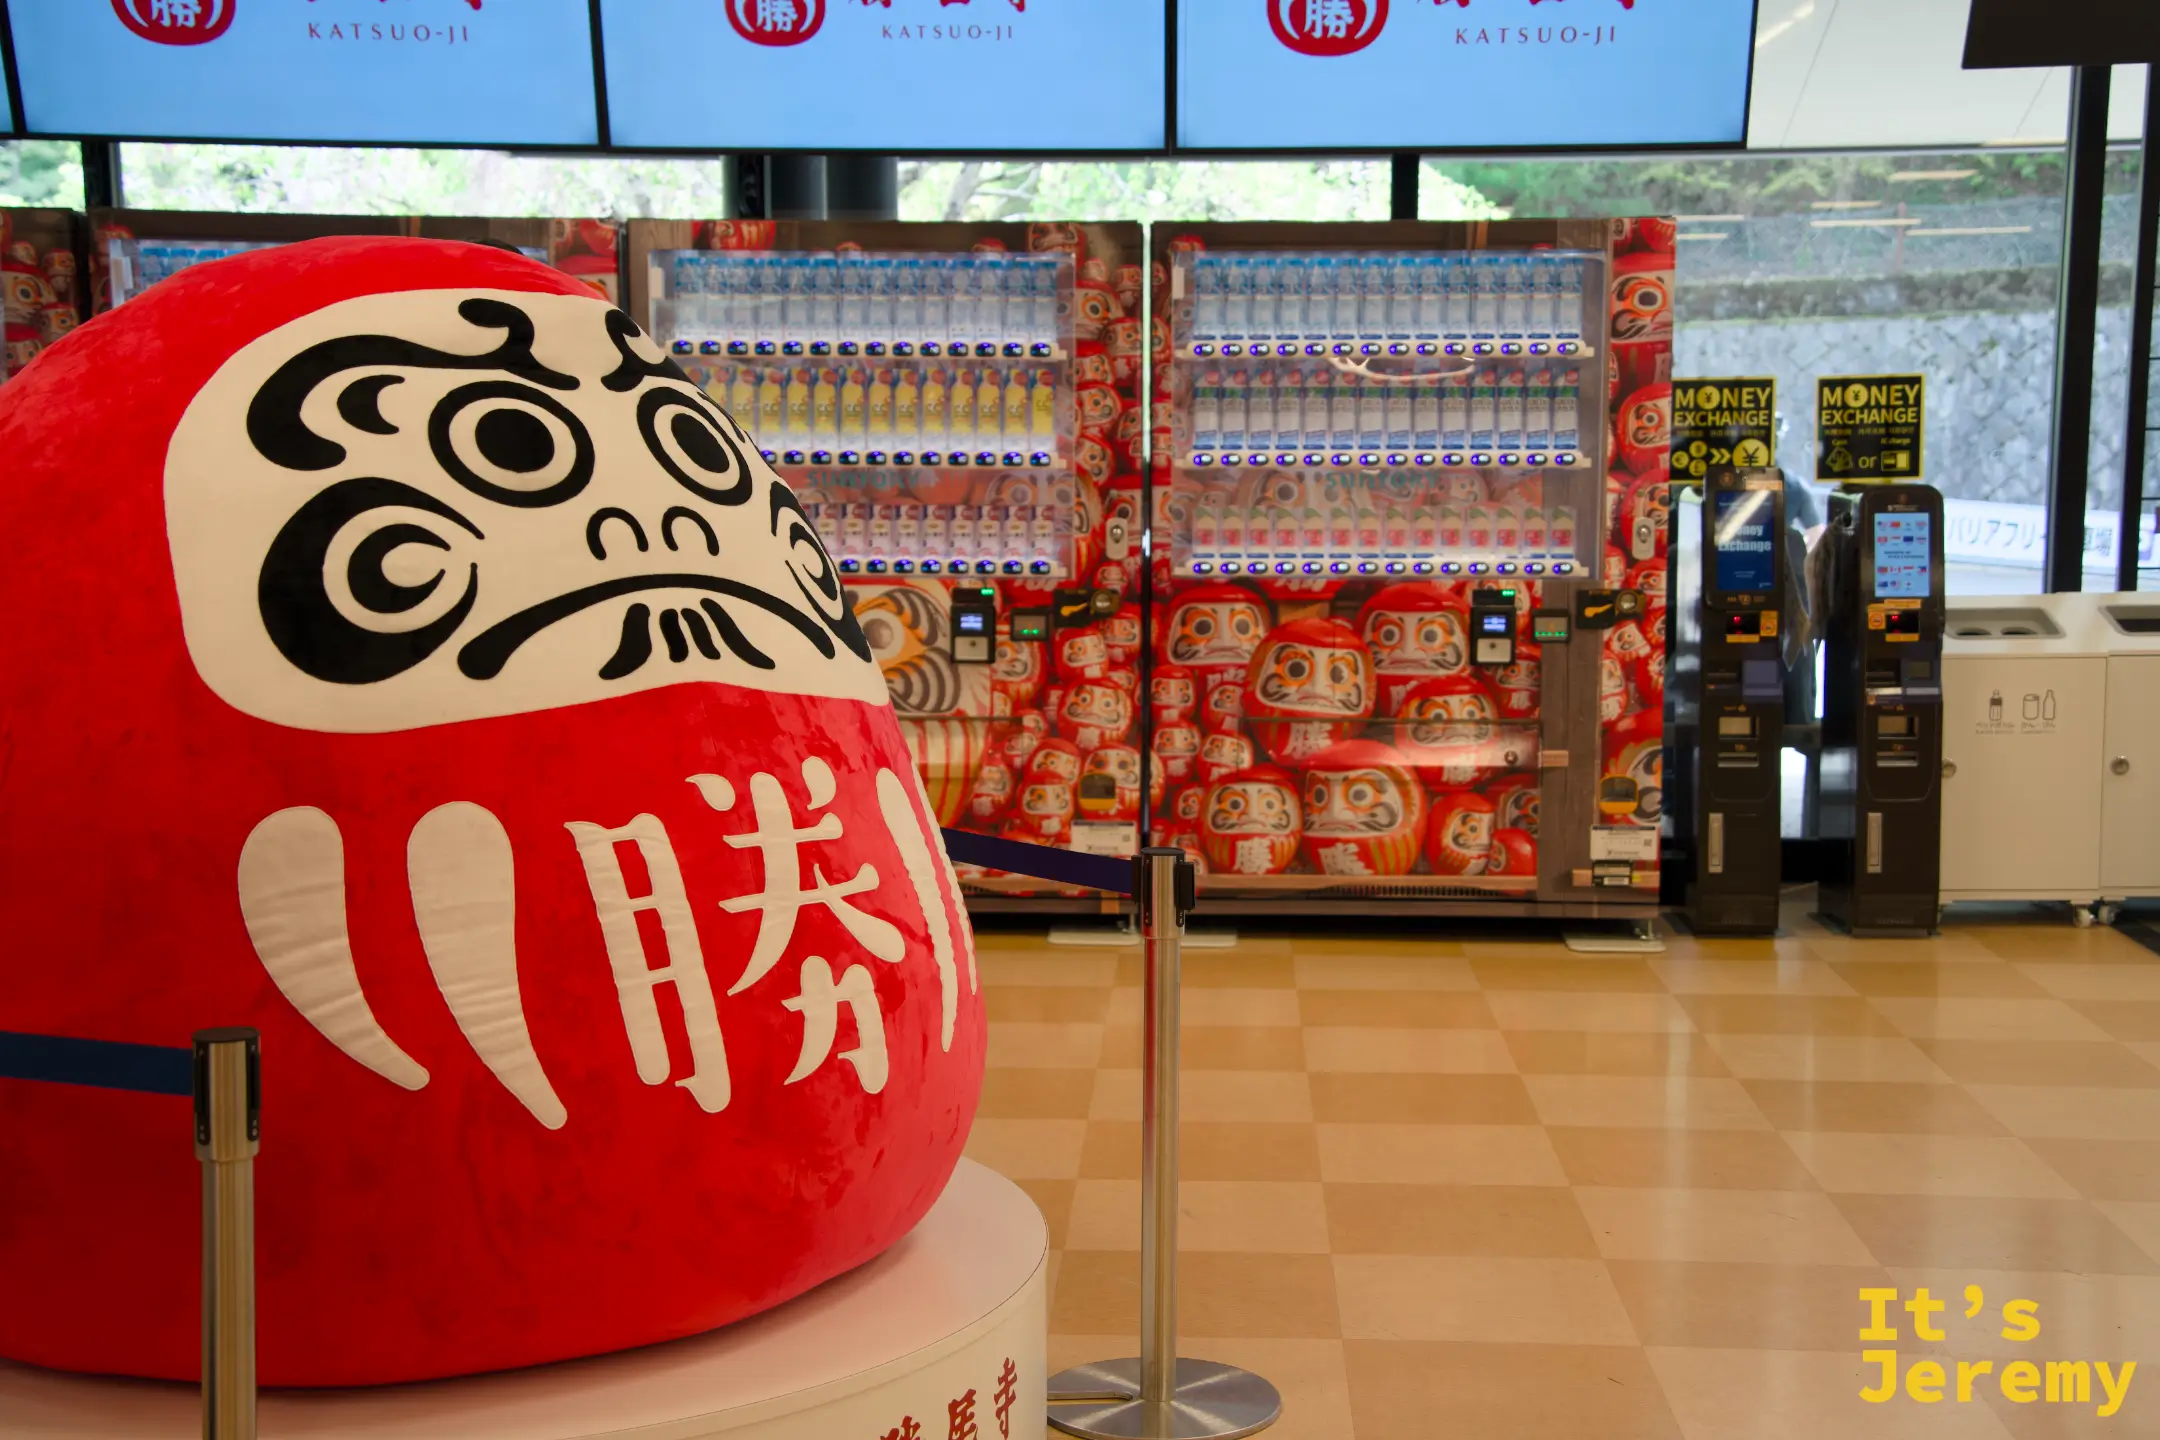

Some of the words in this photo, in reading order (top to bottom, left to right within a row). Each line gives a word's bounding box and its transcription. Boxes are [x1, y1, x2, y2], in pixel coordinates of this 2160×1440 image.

[308, 22, 470, 44] KATSUO-JI
[882, 25, 1013, 41] KATSUO-JI
[1454, 25, 1615, 46] KATSUO-JI
[1674, 410, 1769, 427] EXCHANGE
[1821, 407, 1918, 425] EXCHANGE
[1858, 456, 1877, 469] or
[564, 757, 905, 1113] 勝
